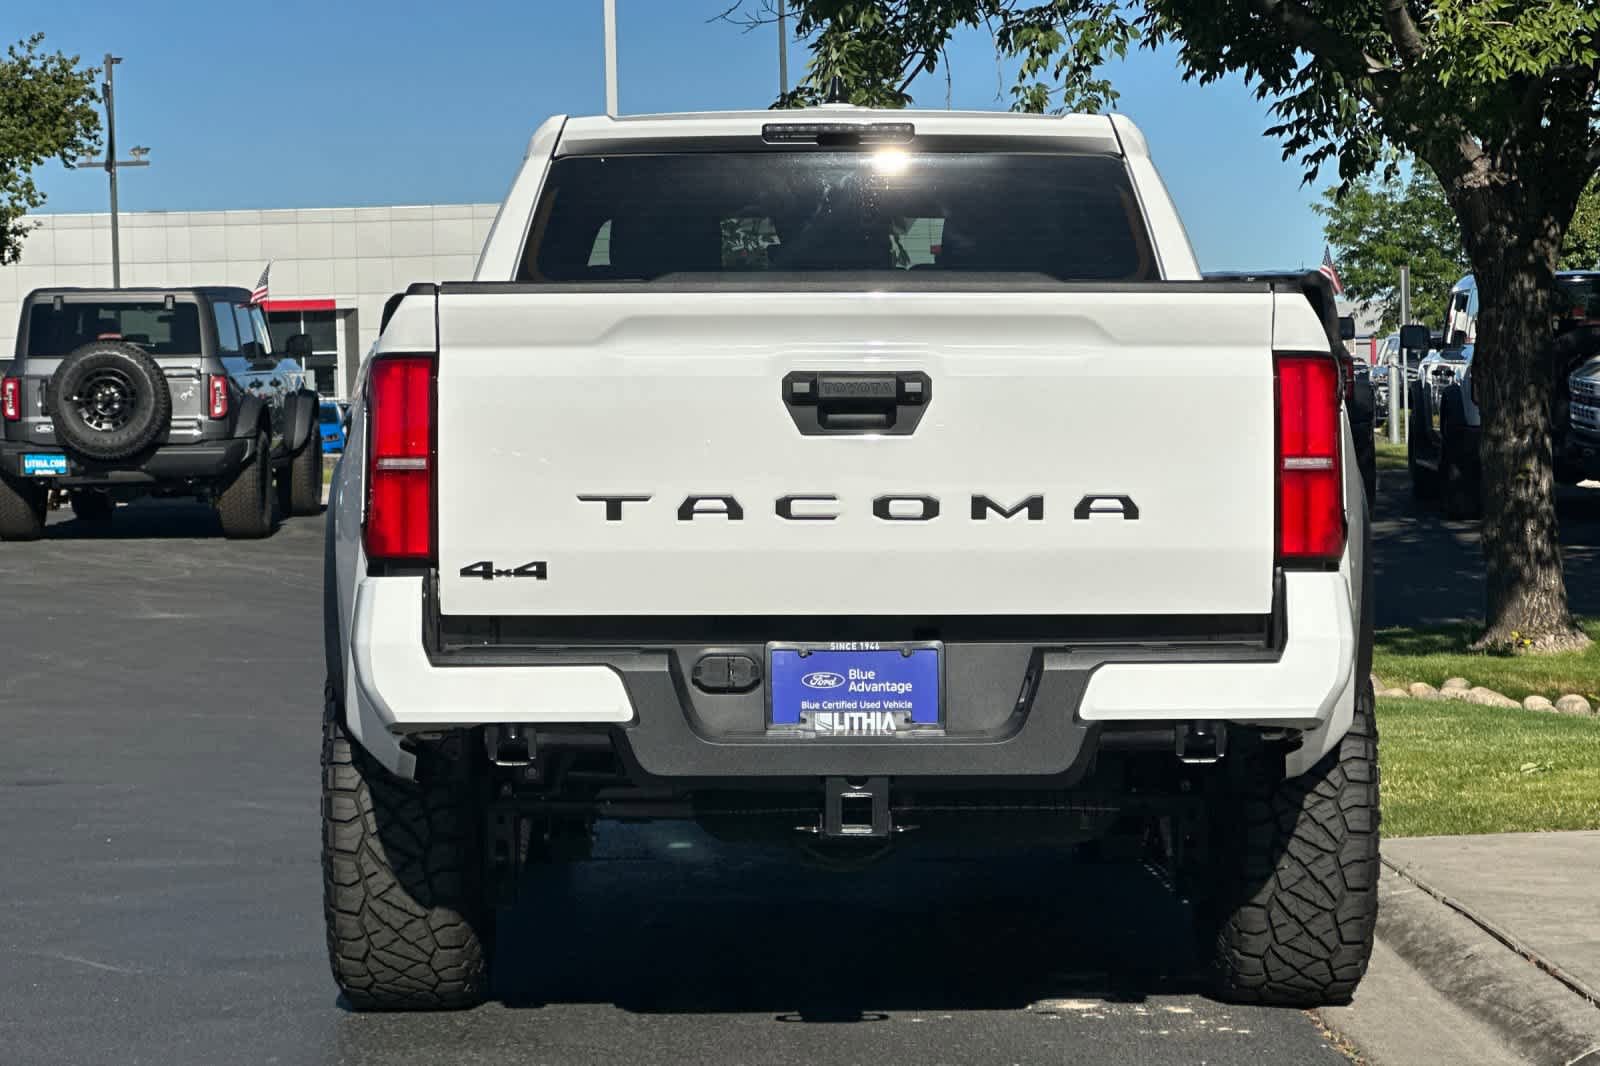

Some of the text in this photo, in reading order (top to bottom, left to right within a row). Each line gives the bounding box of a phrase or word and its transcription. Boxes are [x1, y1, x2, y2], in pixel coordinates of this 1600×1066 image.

[823, 382, 894, 394] TOYOTA
[576, 495, 1139, 520] TACOMA
[830, 642, 880, 650] SINCE 1946
[809, 674, 837, 686] Ford
[848, 668, 876, 680] Blue
[848, 681, 913, 693] Advantage
[801, 701, 913, 709] Blue Certified Used Vehicle
[833, 712, 897, 731] LITHIA
